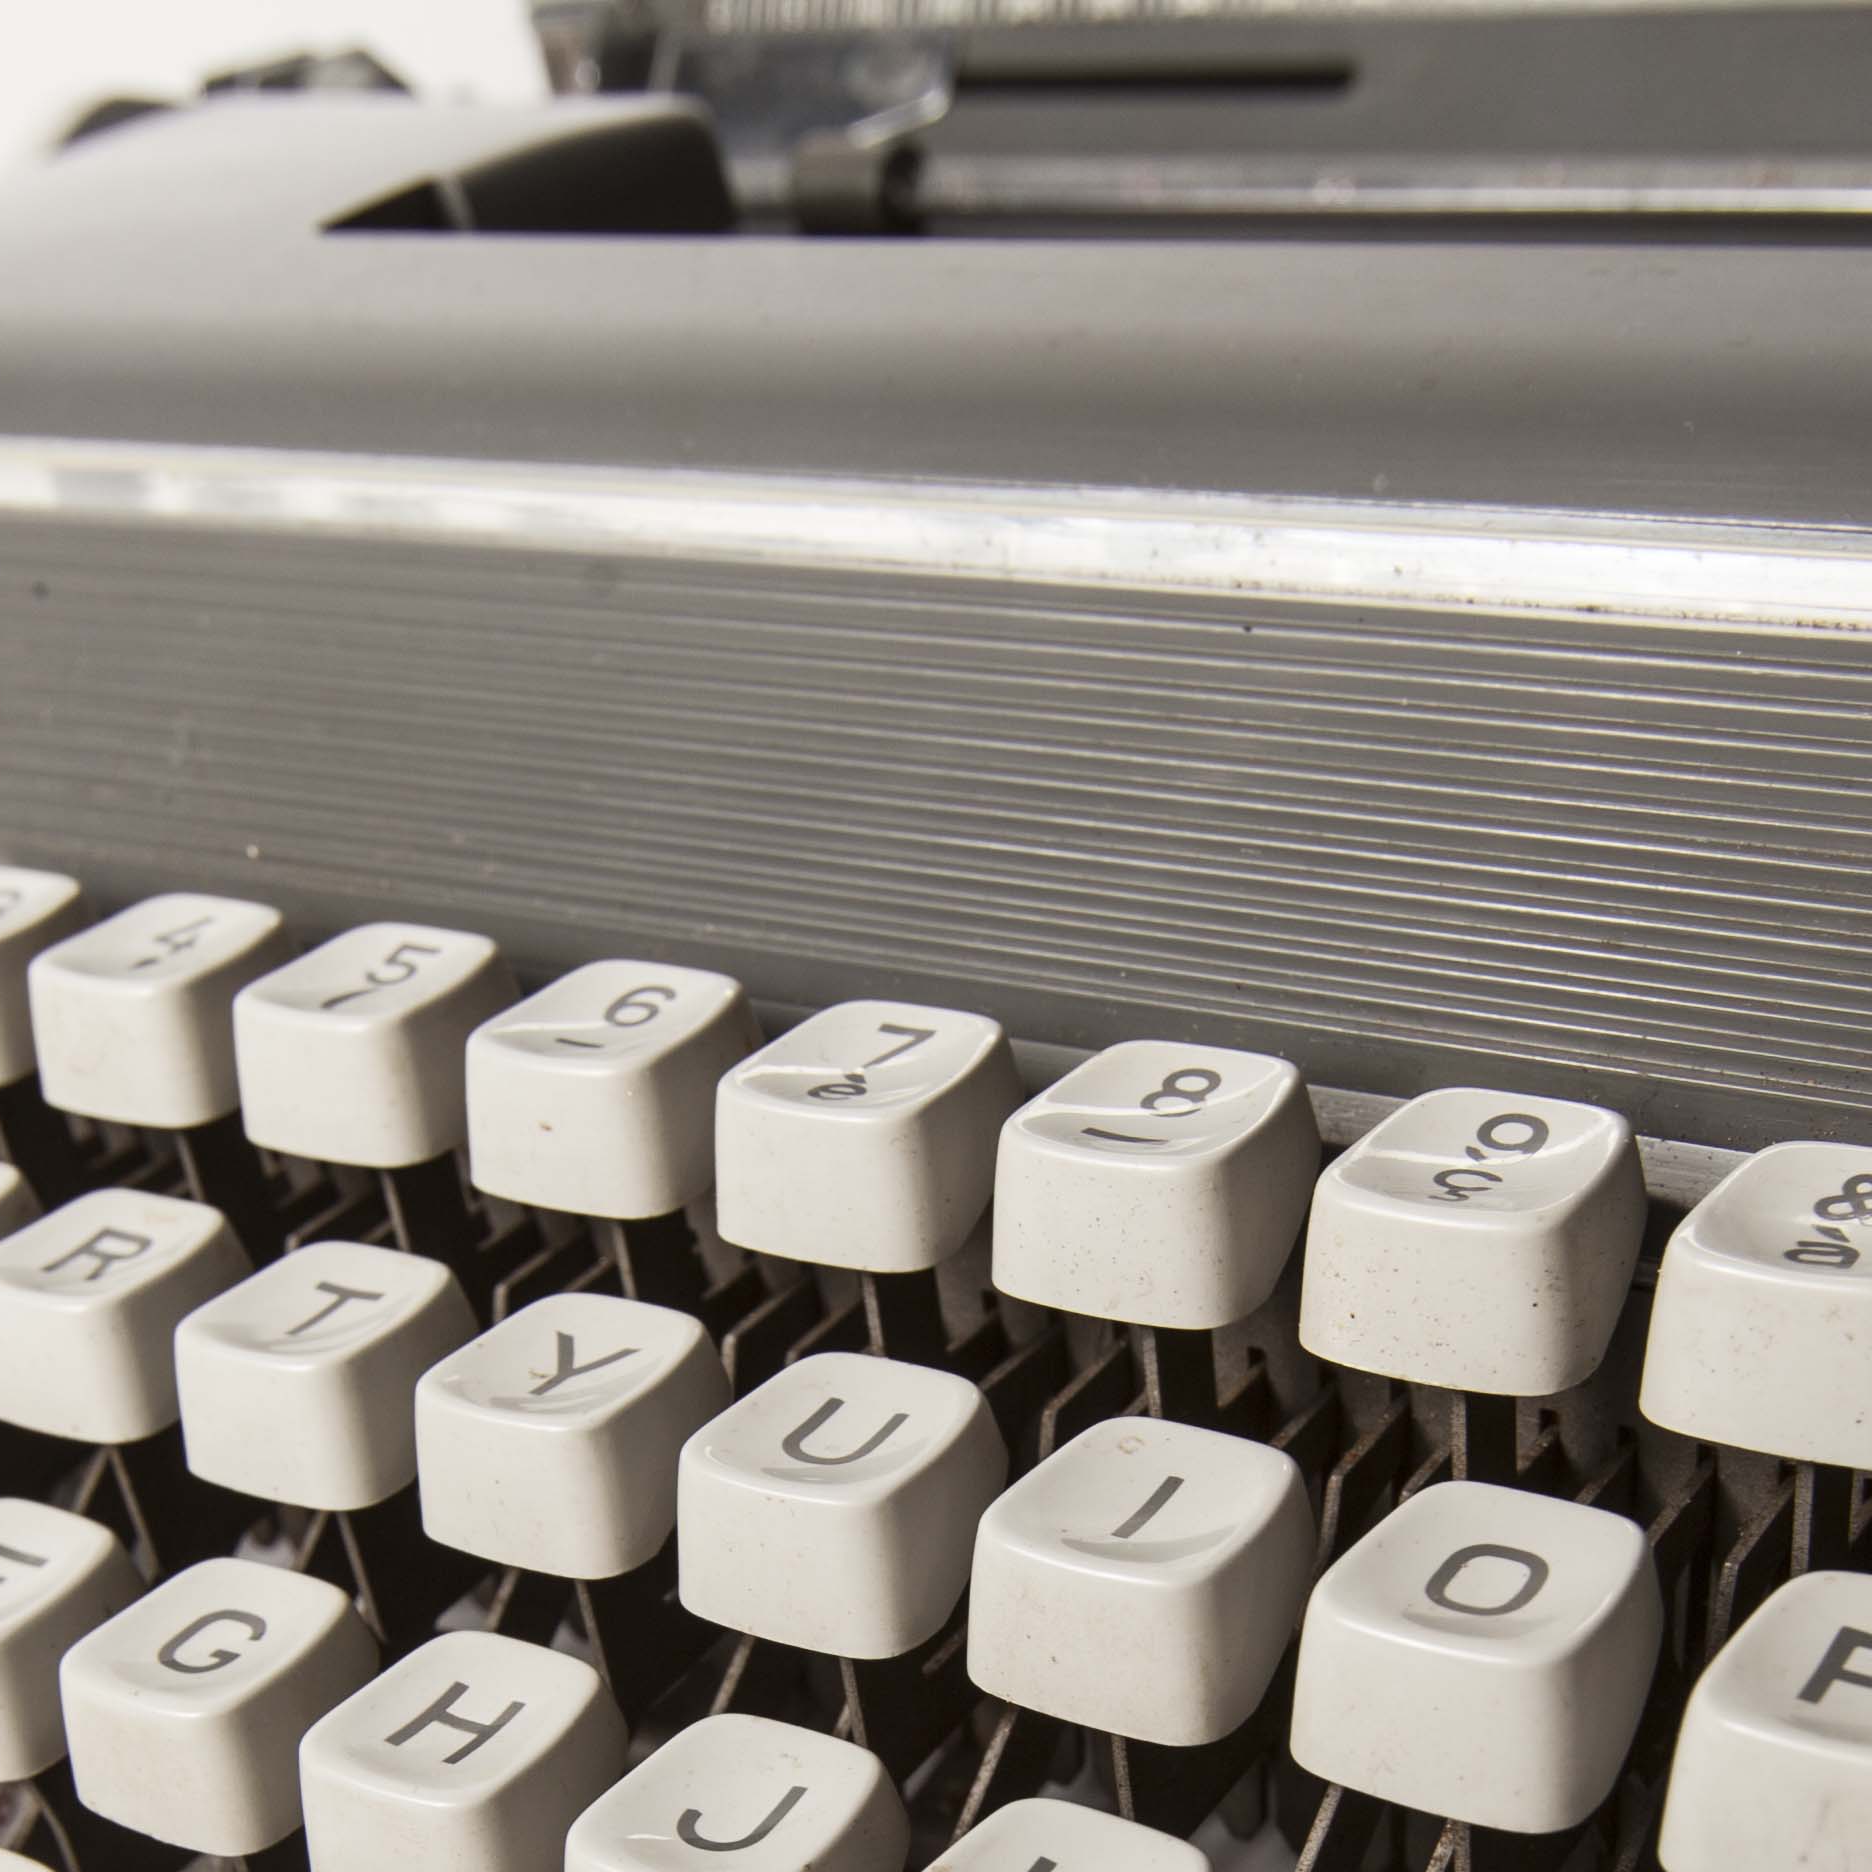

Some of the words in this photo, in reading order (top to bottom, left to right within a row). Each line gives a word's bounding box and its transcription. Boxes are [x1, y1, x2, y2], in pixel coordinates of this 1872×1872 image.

[365, 944, 441, 985] 5
[604, 986, 676, 1027] 6
[863, 1024, 936, 1068] 7
[1140, 1069, 1221, 1117] 8
[42, 1228, 152, 1281] R
[285, 1281, 385, 1337] T
[529, 1331, 640, 1396] Y
[782, 1398, 909, 1465] U
[1112, 1476, 1184, 1538] I
[1425, 1544, 1548, 1616] O
[158, 1610, 266, 1674] G
[384, 1680, 527, 1765] H
[677, 1786, 807, 1852] J
